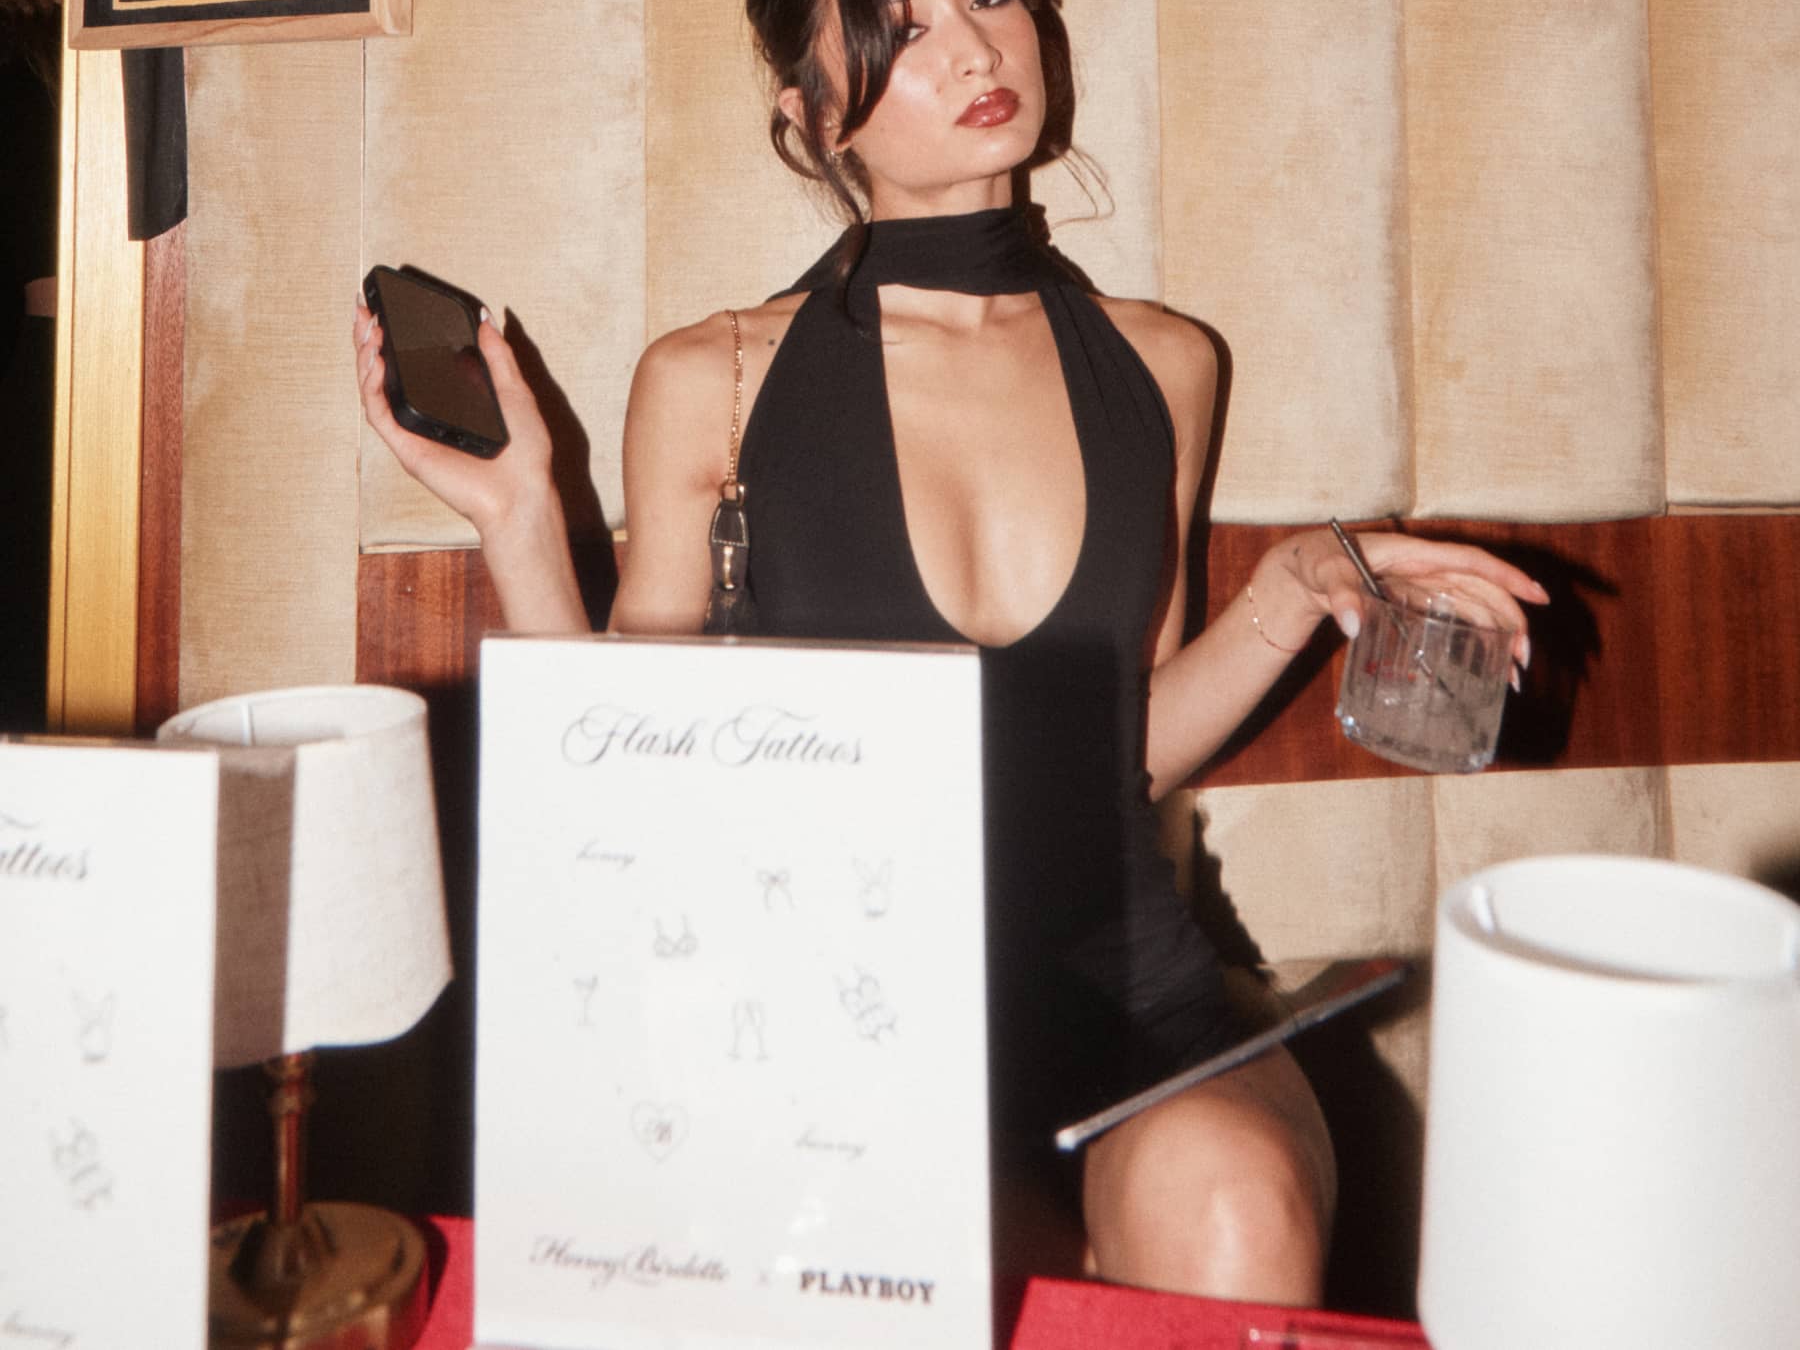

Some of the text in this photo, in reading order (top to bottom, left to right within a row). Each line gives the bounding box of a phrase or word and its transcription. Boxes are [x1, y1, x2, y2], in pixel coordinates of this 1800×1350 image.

[560, 704, 864, 768] Flash Tattoos
[798, 1270, 936, 1306] PLAYBOY
